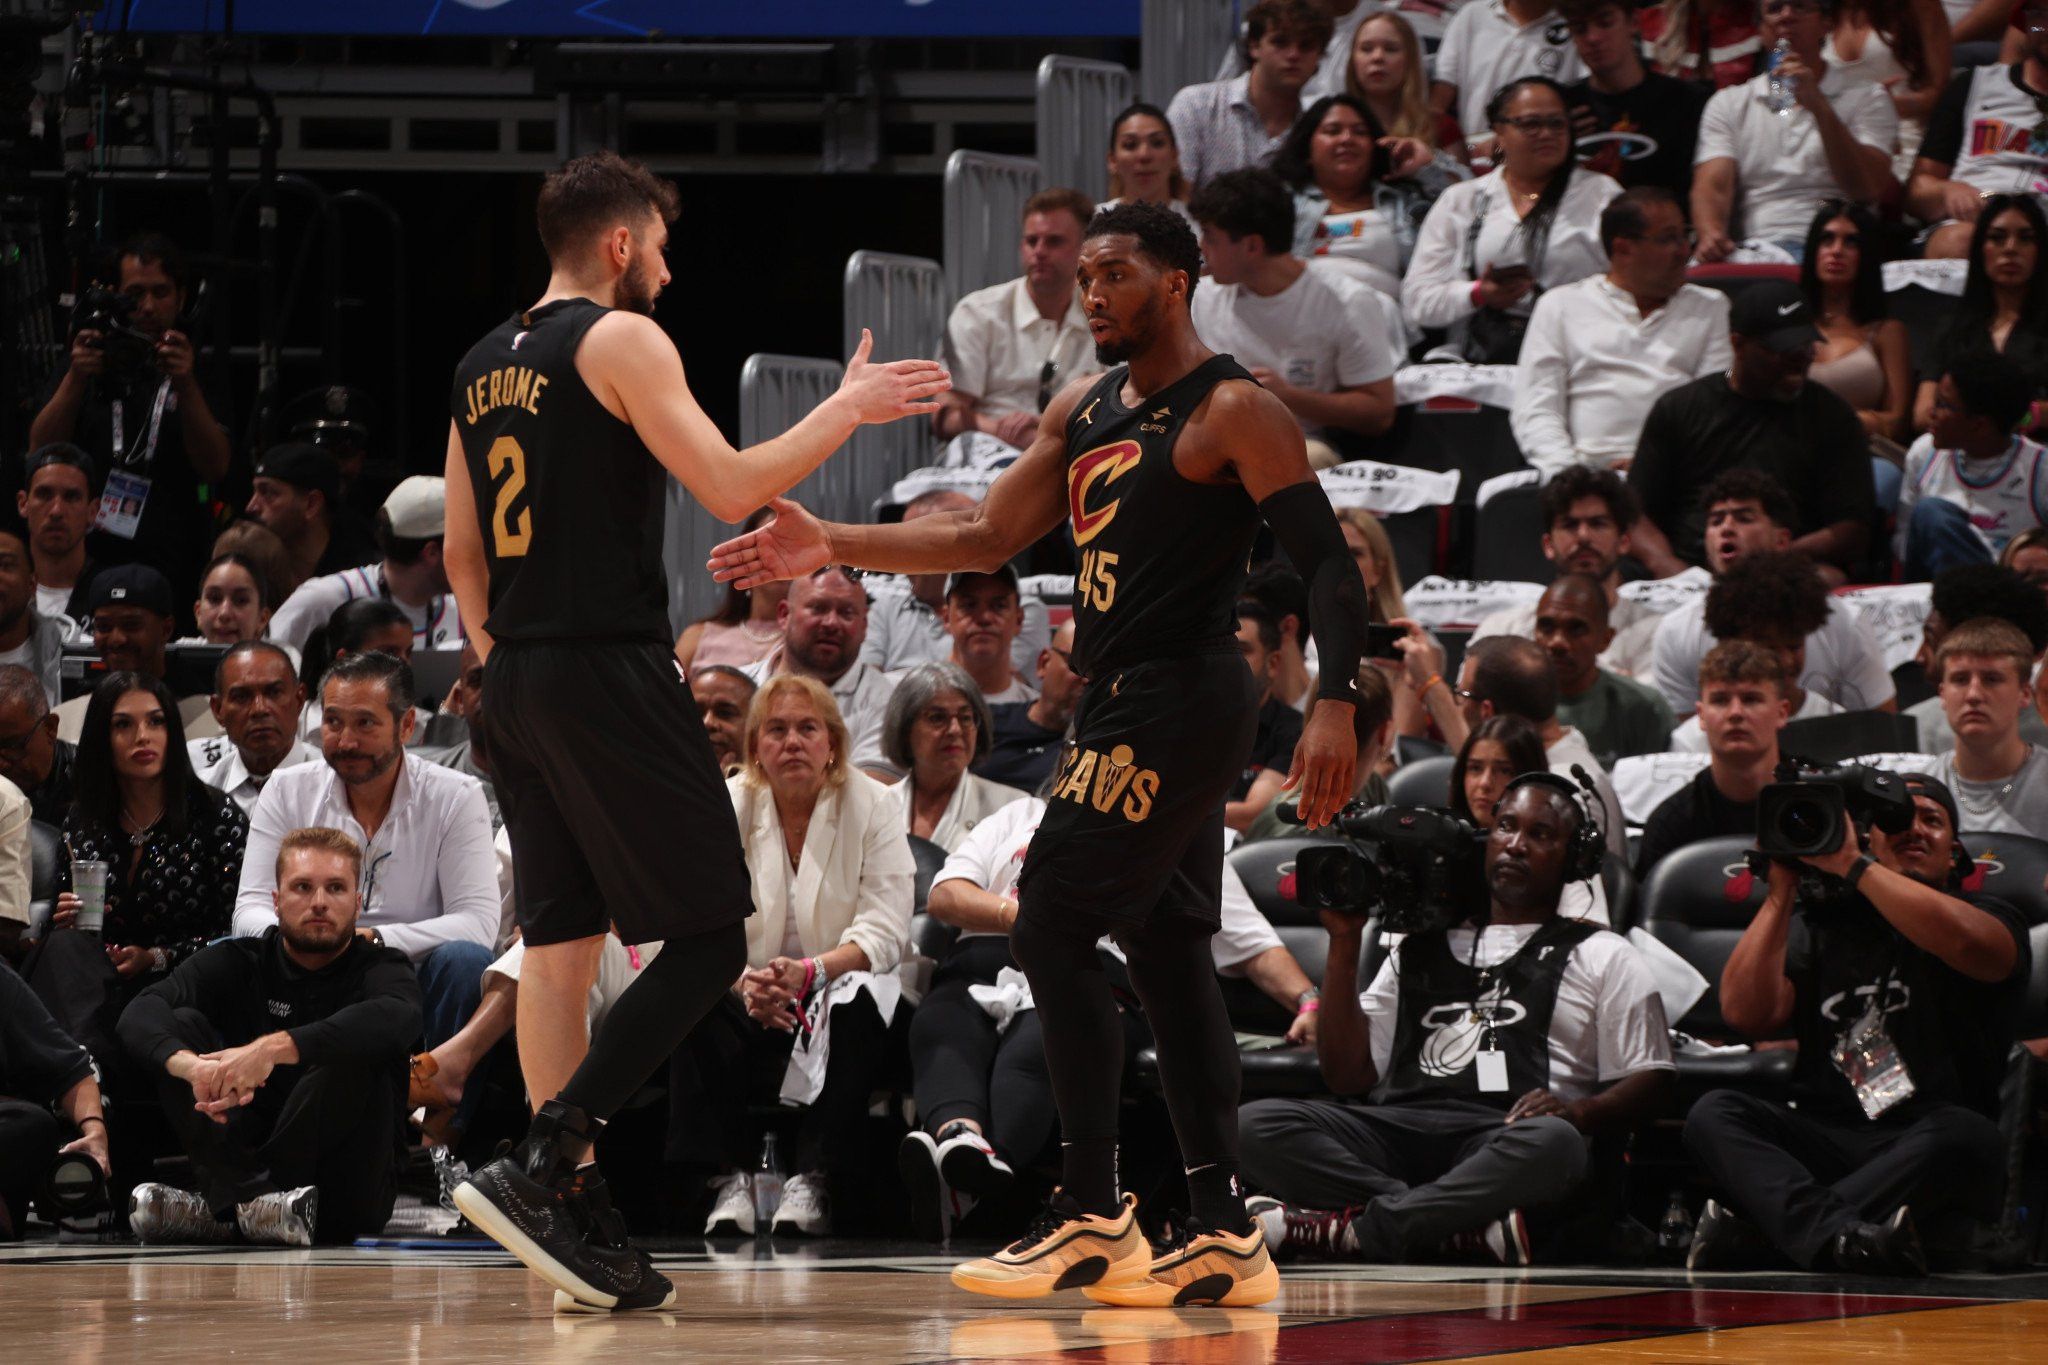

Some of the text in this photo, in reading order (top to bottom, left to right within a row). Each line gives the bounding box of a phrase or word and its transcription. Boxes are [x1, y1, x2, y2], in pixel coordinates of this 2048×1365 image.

[466, 366, 549, 425] JEROME
[1141, 423, 1167, 433] CLIFFS
[487, 435, 533, 557] 2
[1079, 549, 1120, 613] 45
